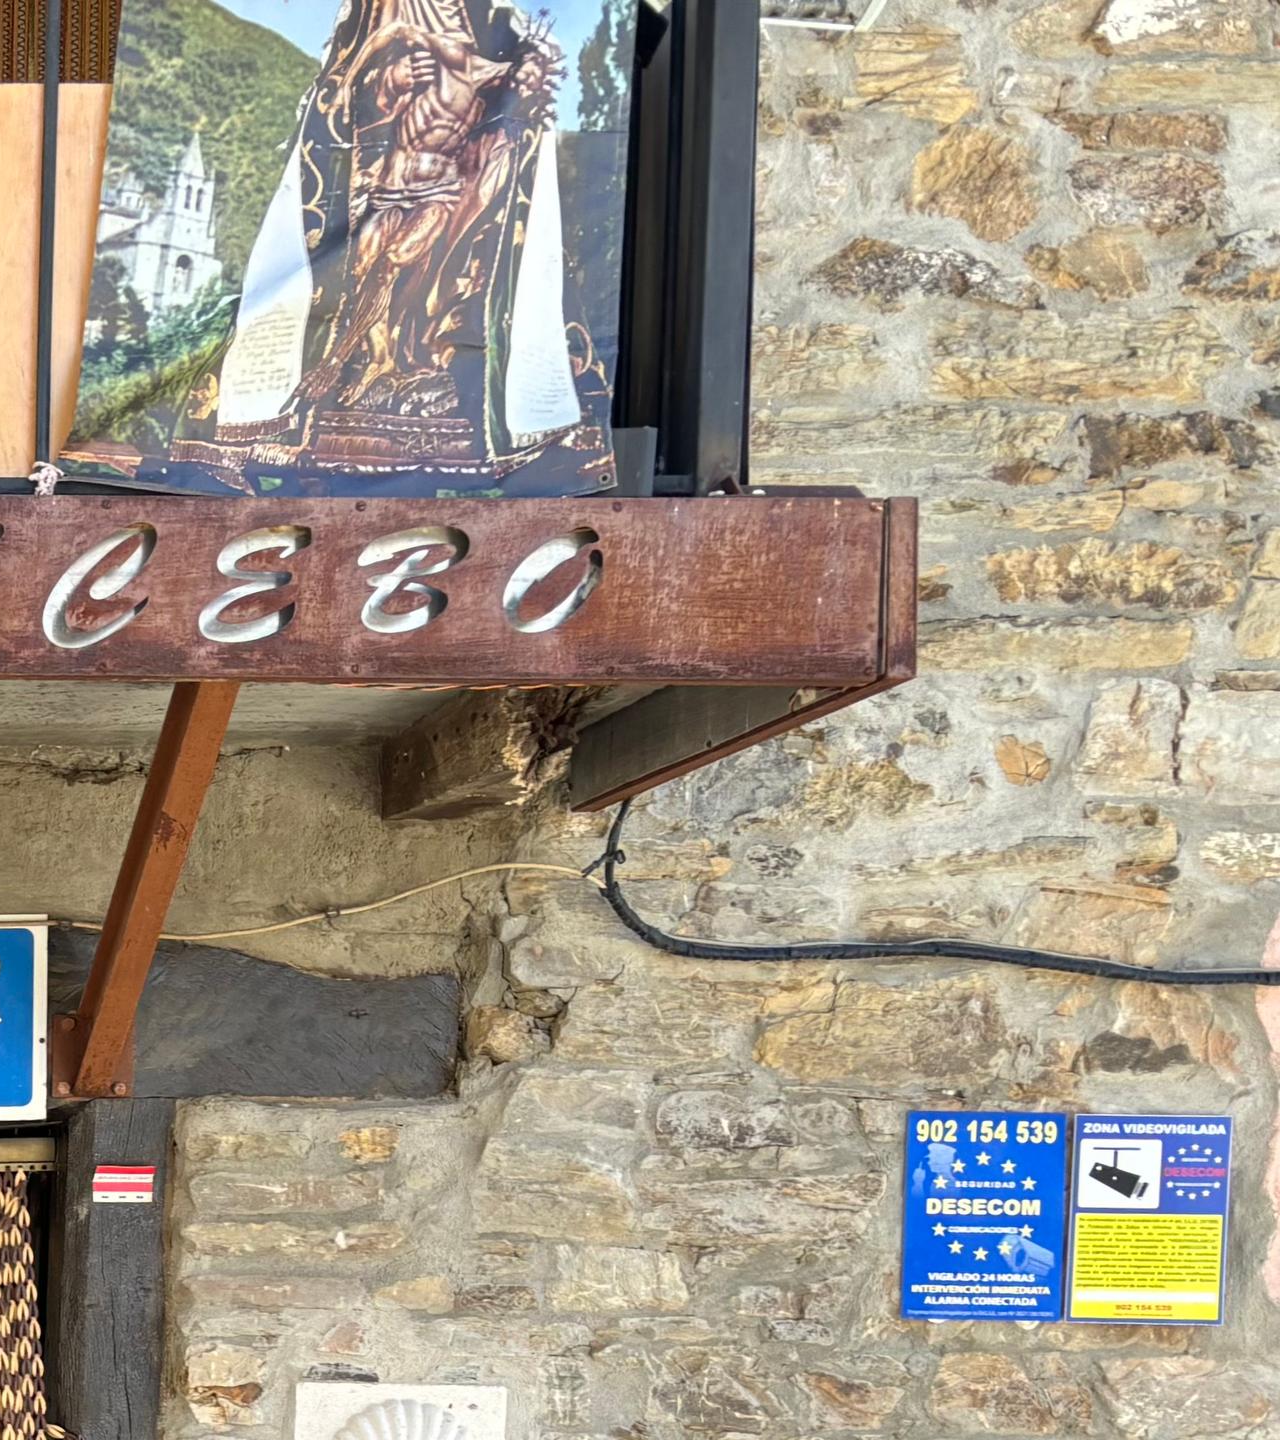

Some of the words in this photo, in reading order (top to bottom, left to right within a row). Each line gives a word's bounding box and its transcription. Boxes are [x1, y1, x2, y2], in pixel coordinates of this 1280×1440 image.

[916, 1119, 958, 1143] 902
[965, 1119, 1008, 1144] 154
[1016, 1120, 1058, 1144] 539
[1082, 1122, 1121, 1134] ZONA
[1124, 1123, 1227, 1136] VIDEOVIGILADA
[954, 1180, 1017, 1189] SEGURIDAD
[926, 1198, 1041, 1216] DESECOM
[927, 1272, 980, 1282] VIGILADO
[981, 1273, 996, 1282] 24
[997, 1273, 1036, 1283] HORAS
[911, 1284, 990, 1294] INTERVENCIÓN
[991, 1286, 1051, 1295] INMEDIATA
[924, 1296, 971, 1305] ALARMA
[971, 1297, 1038, 1306] CONECTADA
